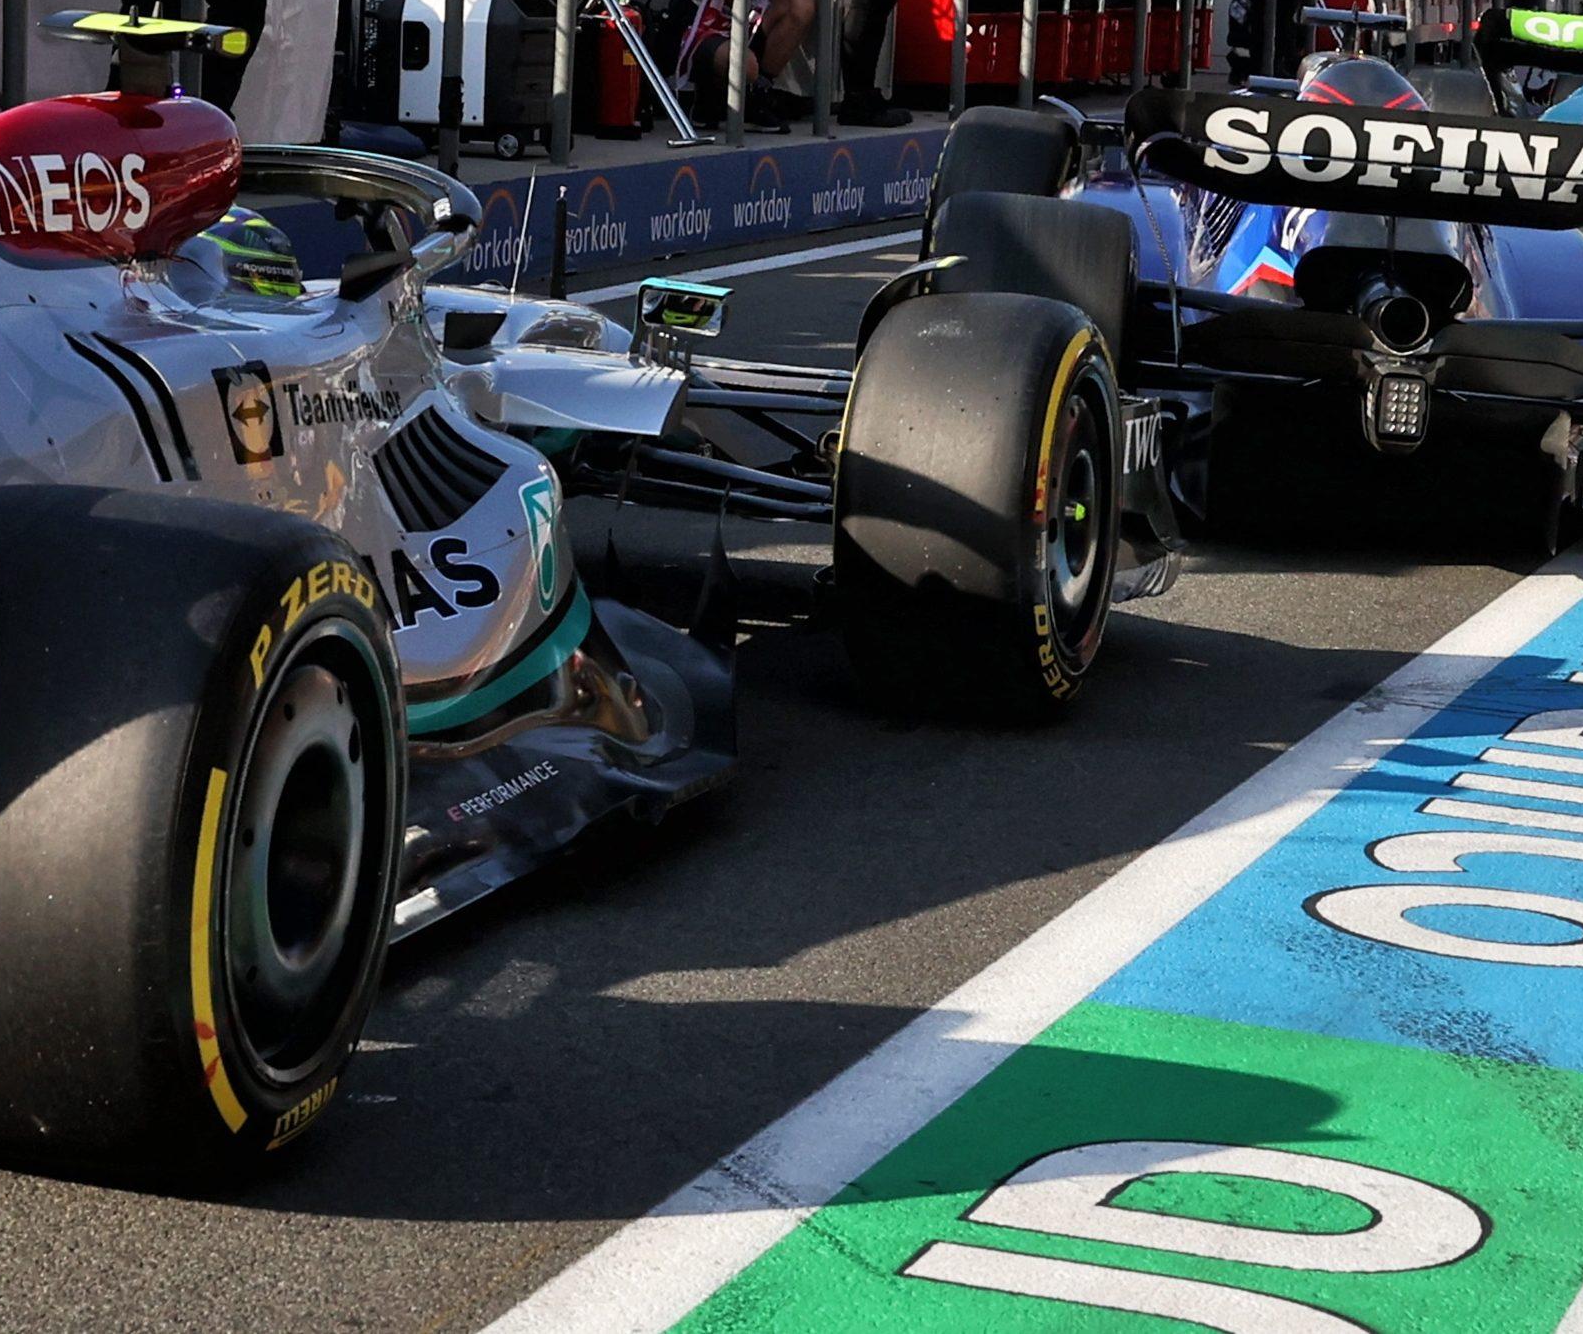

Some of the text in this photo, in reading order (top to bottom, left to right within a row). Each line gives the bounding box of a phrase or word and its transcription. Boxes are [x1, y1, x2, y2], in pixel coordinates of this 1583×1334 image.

[650, 201, 712, 241] workday
[733, 191, 792, 228] workday
[812, 178, 865, 217] workday
[283, 375, 404, 427] TeamViewer
[1122, 410, 1177, 475] IWC
[249, 561, 375, 690] P ZERO
[1033, 603, 1072, 701] ZERO
[462, 759, 560, 818] PERFORMANCE
